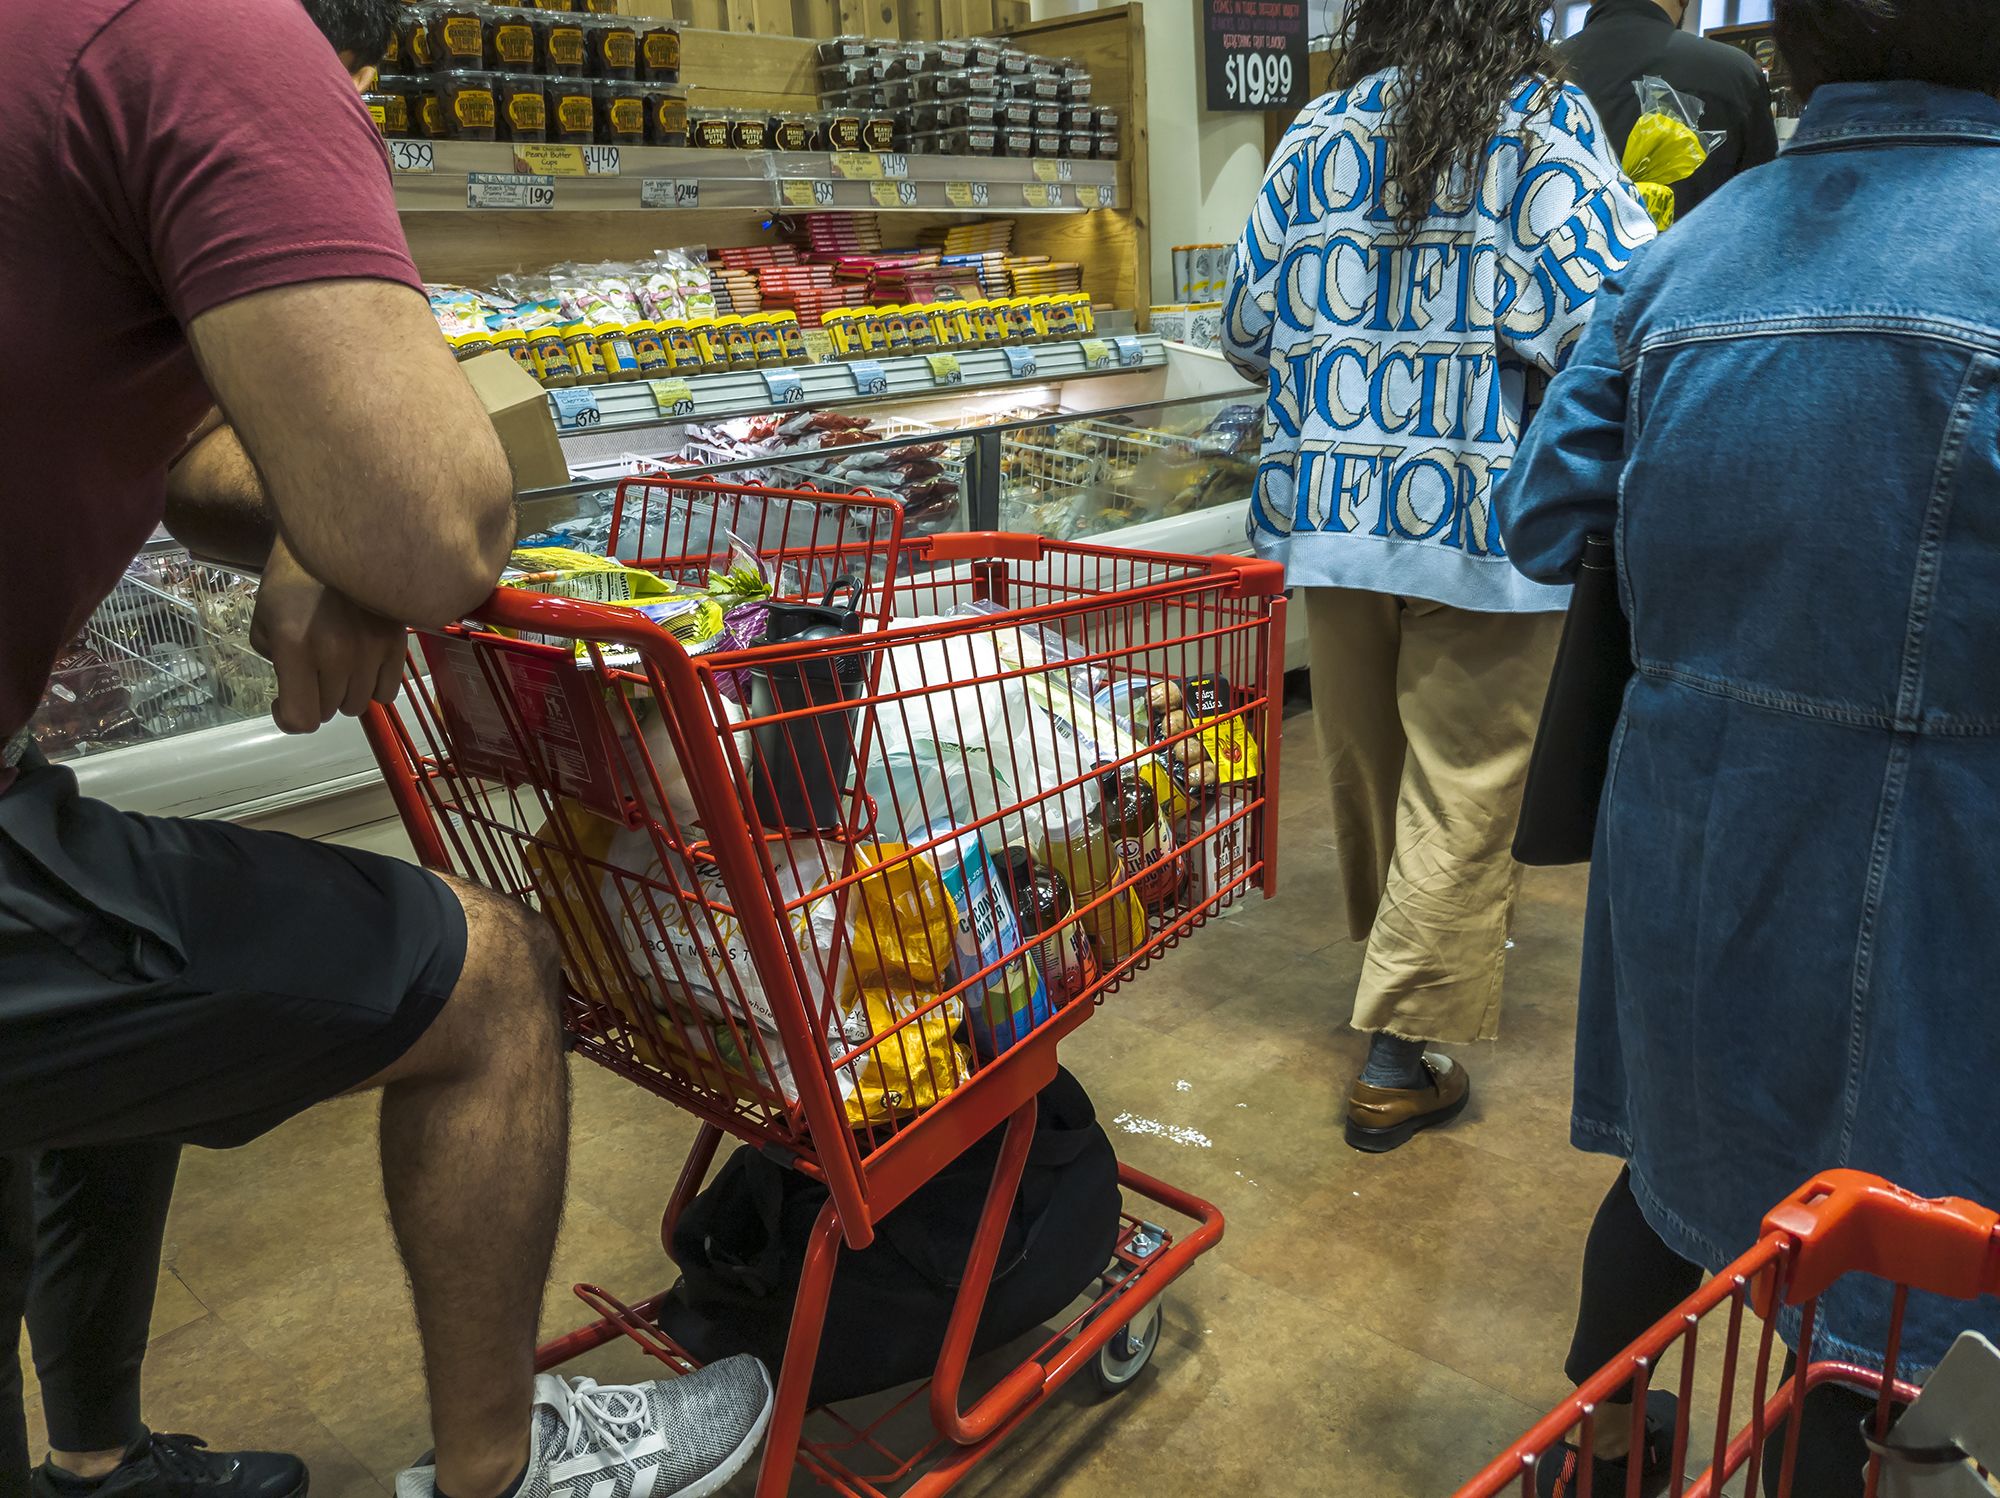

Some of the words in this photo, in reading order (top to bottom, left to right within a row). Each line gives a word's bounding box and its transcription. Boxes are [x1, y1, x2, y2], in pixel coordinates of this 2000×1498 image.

[1225, 52, 1293, 105] $19.99
[541, 159, 558, 168] Cups
[619, 571, 631, 600] utriti
[976, 904, 1006, 945] WATR
